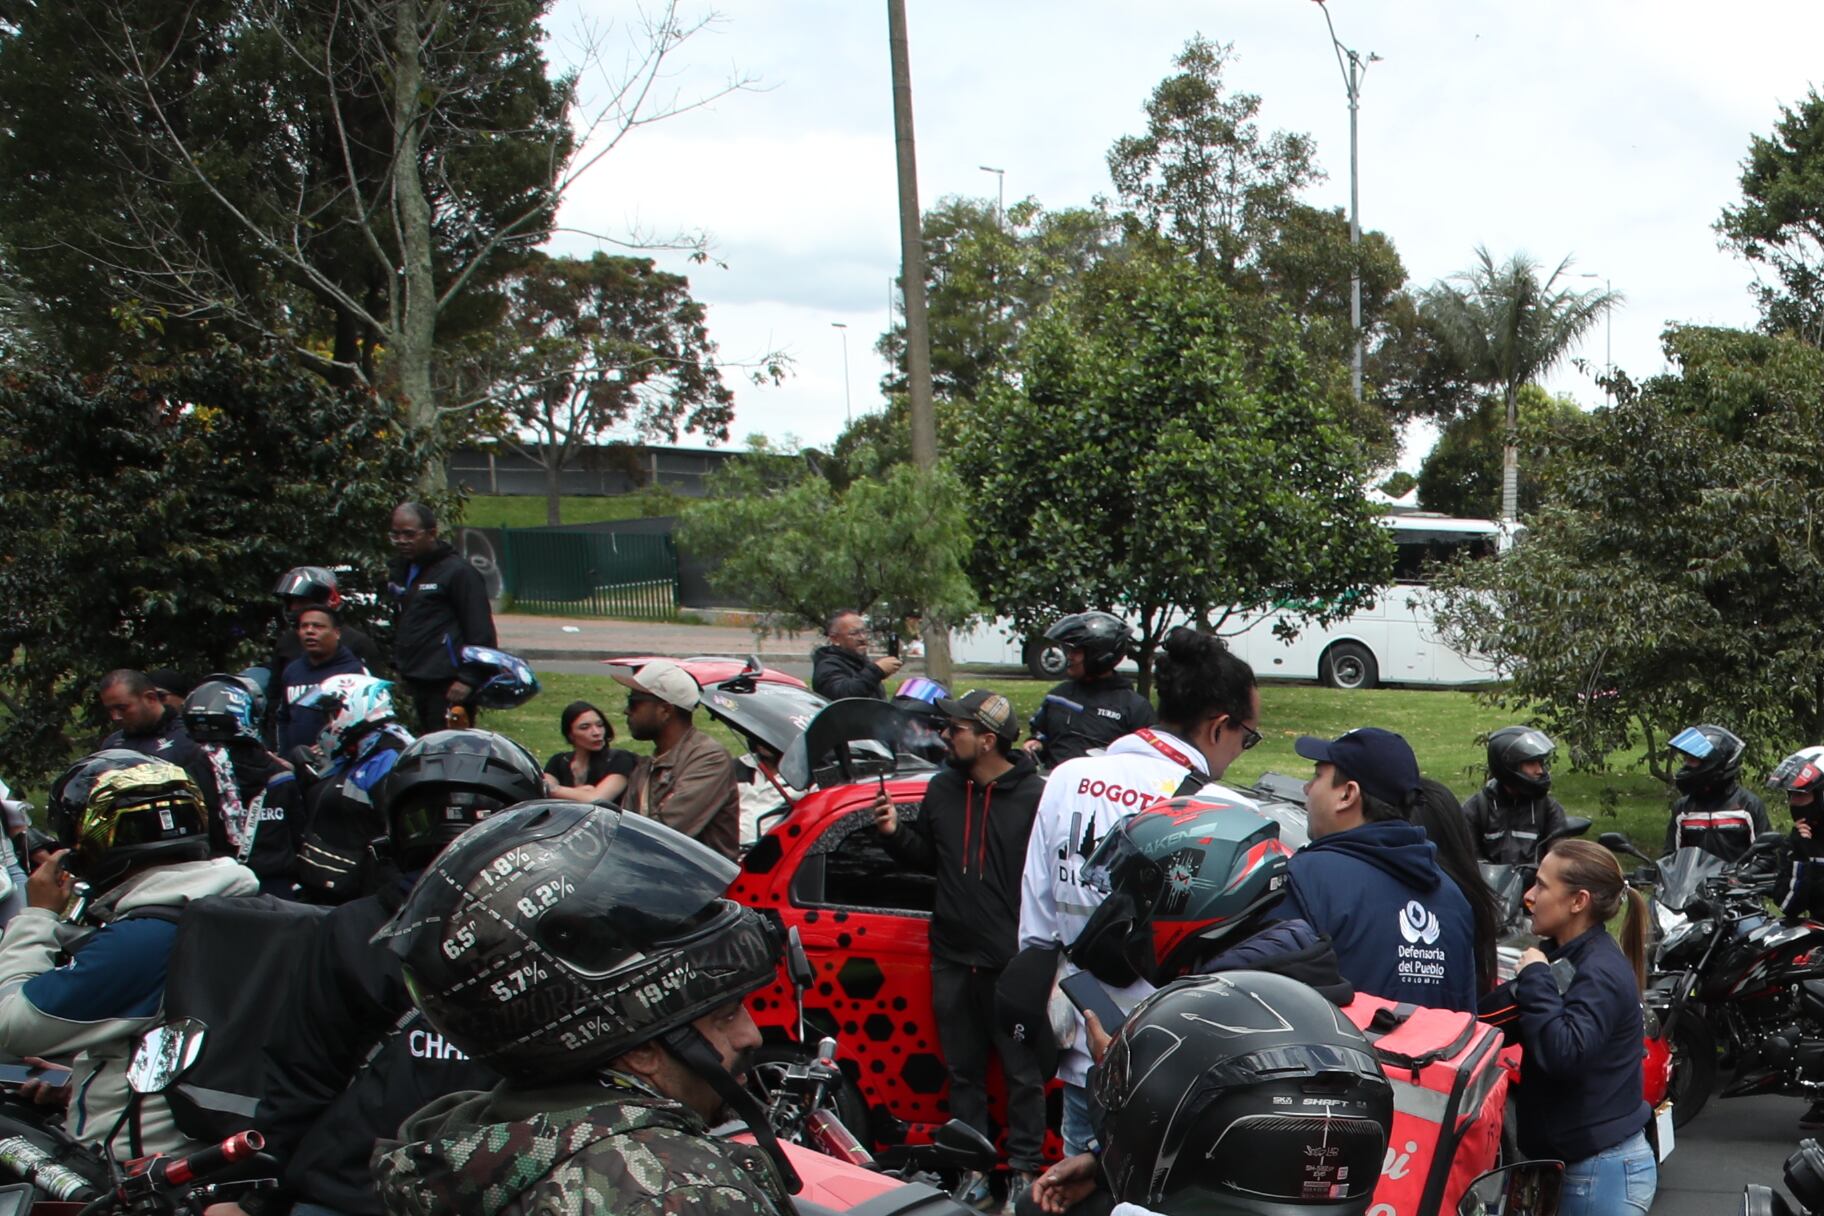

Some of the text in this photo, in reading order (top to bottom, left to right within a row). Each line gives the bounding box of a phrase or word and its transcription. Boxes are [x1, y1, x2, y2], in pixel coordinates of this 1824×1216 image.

[1077, 778, 1172, 811] BOGOT
[480, 847, 530, 886] 1.8%
[517, 875, 576, 918] 8.2%
[490, 961, 548, 1002] 5.7%
[634, 962, 697, 1009] 19.4%
[1398, 961, 1445, 975] del Pueblo
[409, 1030, 470, 1061] CHA
[560, 1015, 611, 1050] 2.1%
[1303, 1098, 1350, 1107] SHAFT
